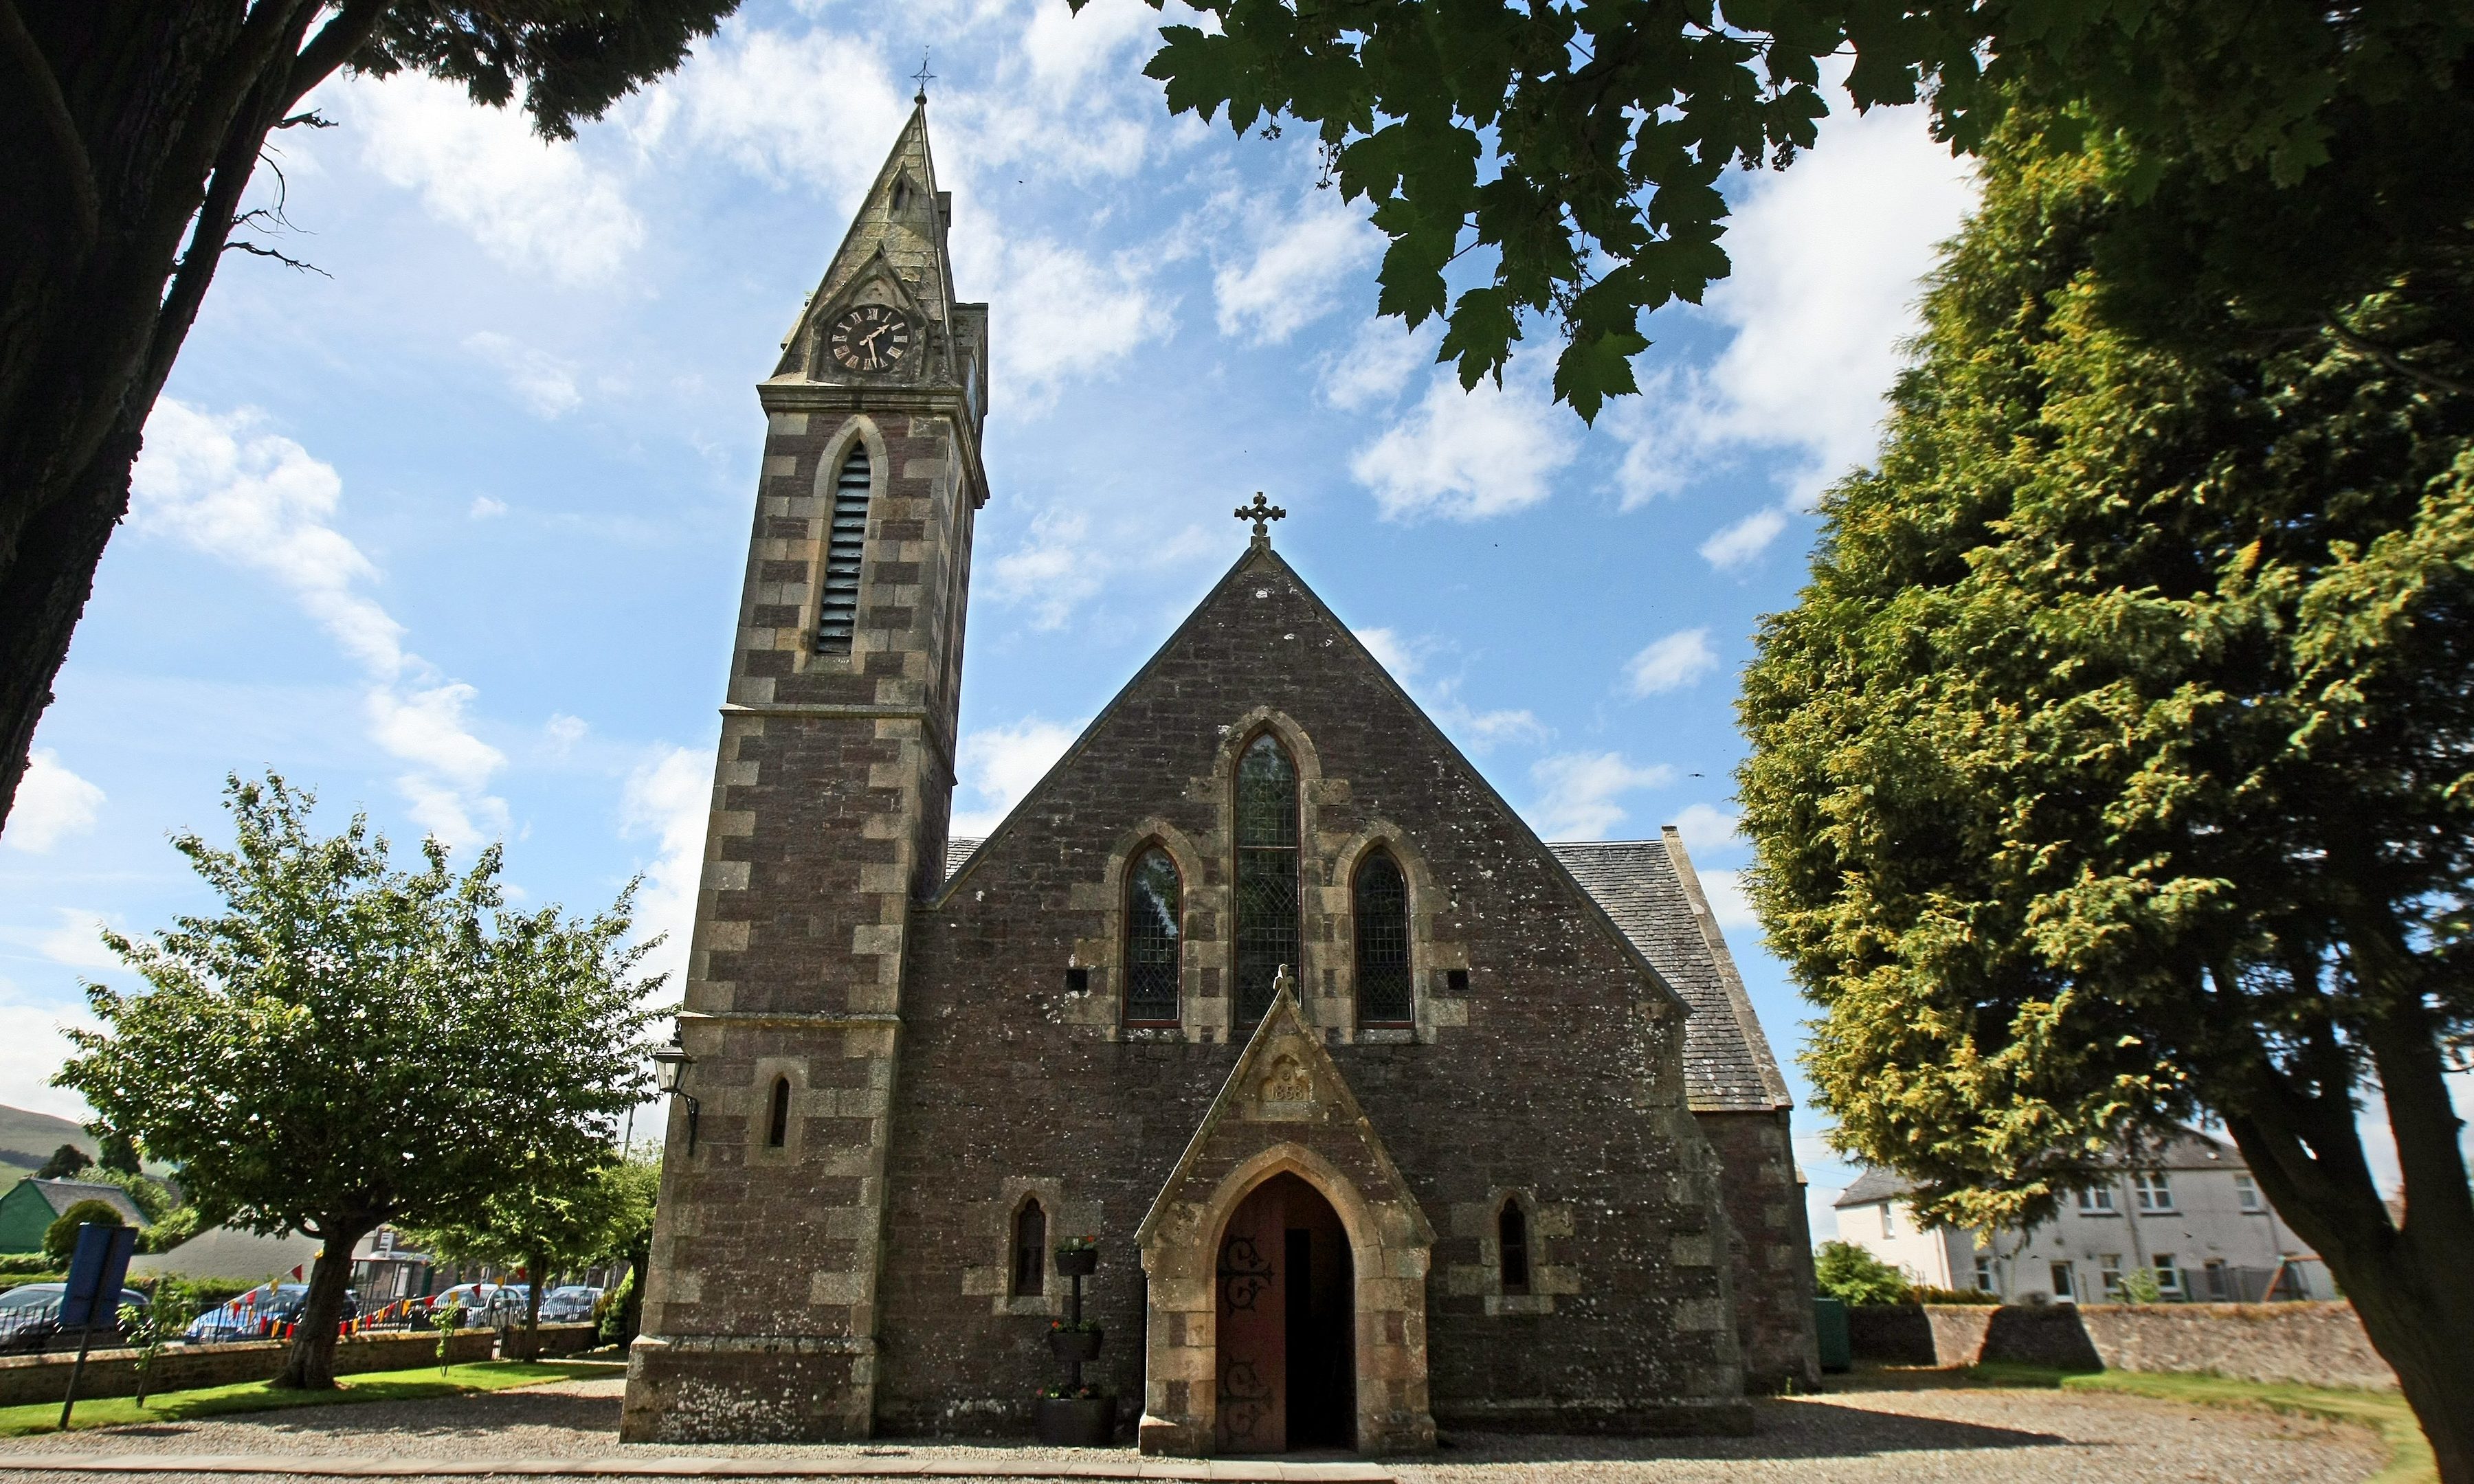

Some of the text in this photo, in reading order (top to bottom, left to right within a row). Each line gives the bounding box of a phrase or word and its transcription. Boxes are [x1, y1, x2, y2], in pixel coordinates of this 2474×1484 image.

[849, 311, 862, 325] XI
[867, 308, 878, 320] XII
[882, 311, 893, 323] I
[837, 322, 853, 333] X
[891, 322, 905, 331] II
[832, 334, 847, 342] IX
[893, 335, 908, 343] III
[833, 344, 850, 360] VIII
[845, 355, 859, 369] VII
[879, 356, 888, 368] V
